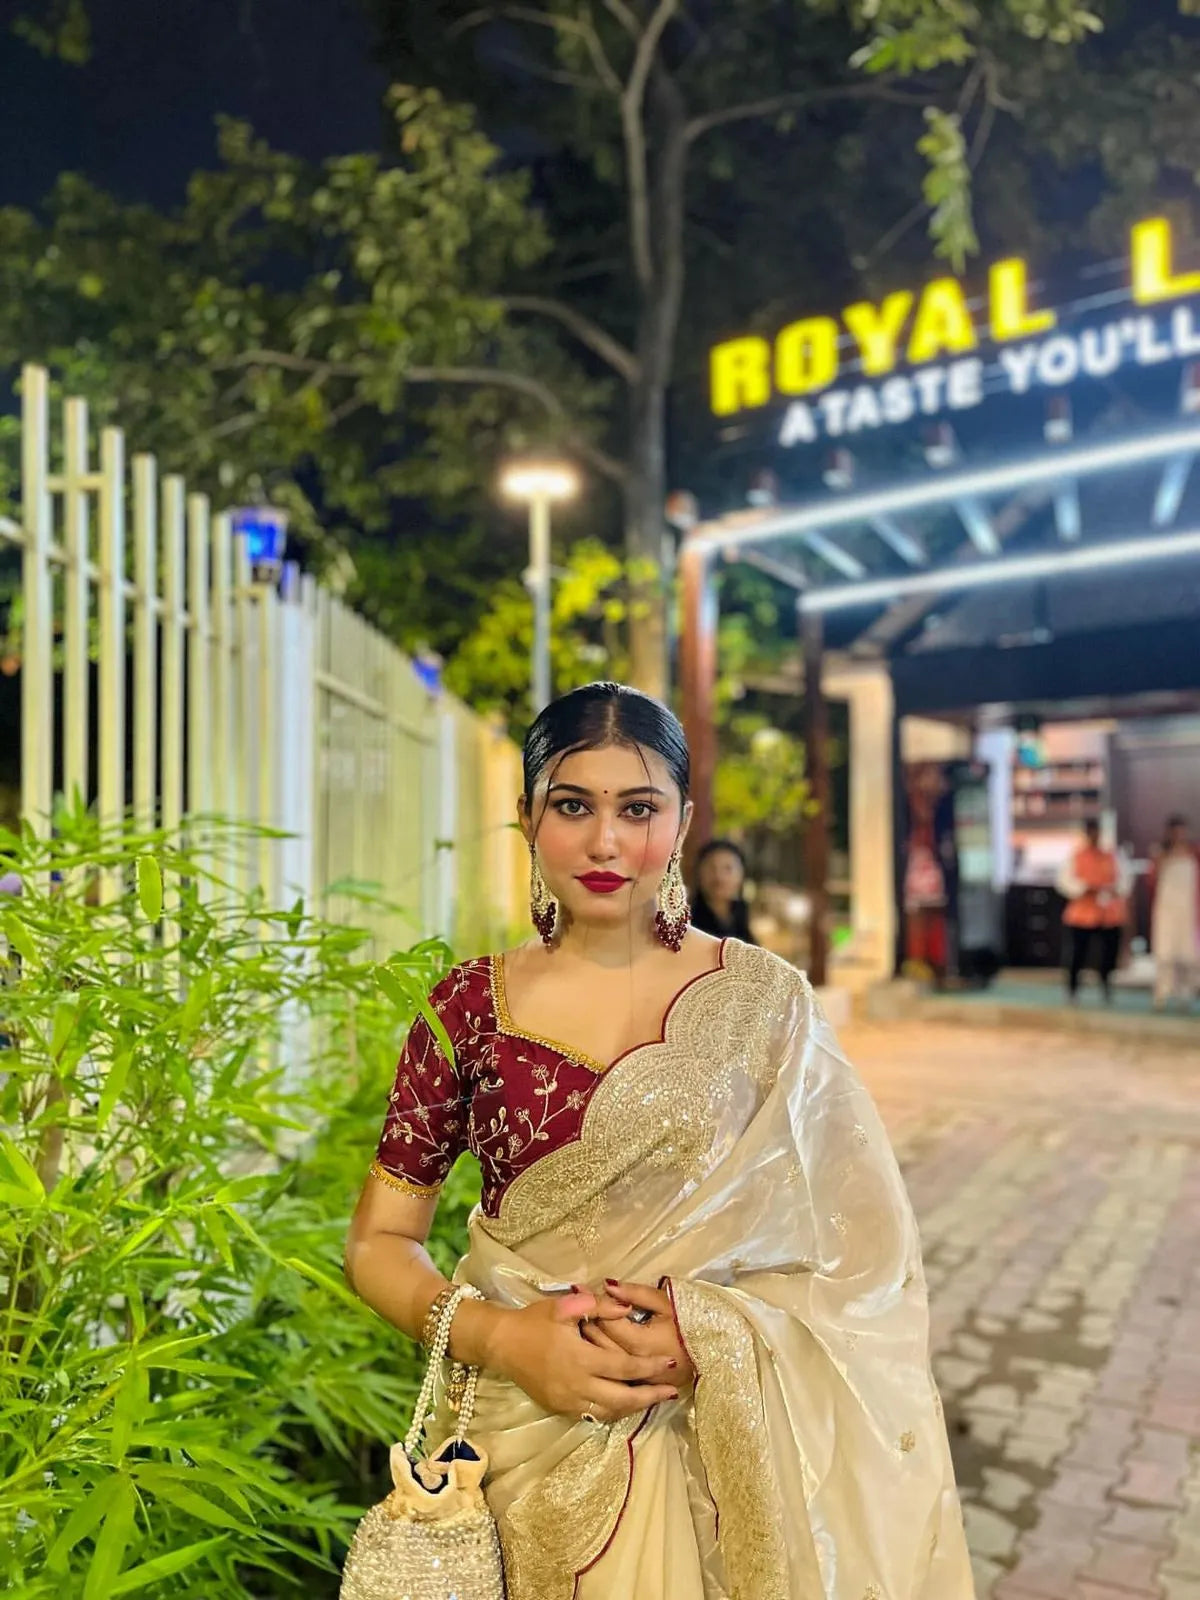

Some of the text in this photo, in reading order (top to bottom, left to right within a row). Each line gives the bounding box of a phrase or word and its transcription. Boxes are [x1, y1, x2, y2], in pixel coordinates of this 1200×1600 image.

[709, 257, 1057, 416] ROYAL
[778, 306, 1200, 448] A TASTE YOU'LL
